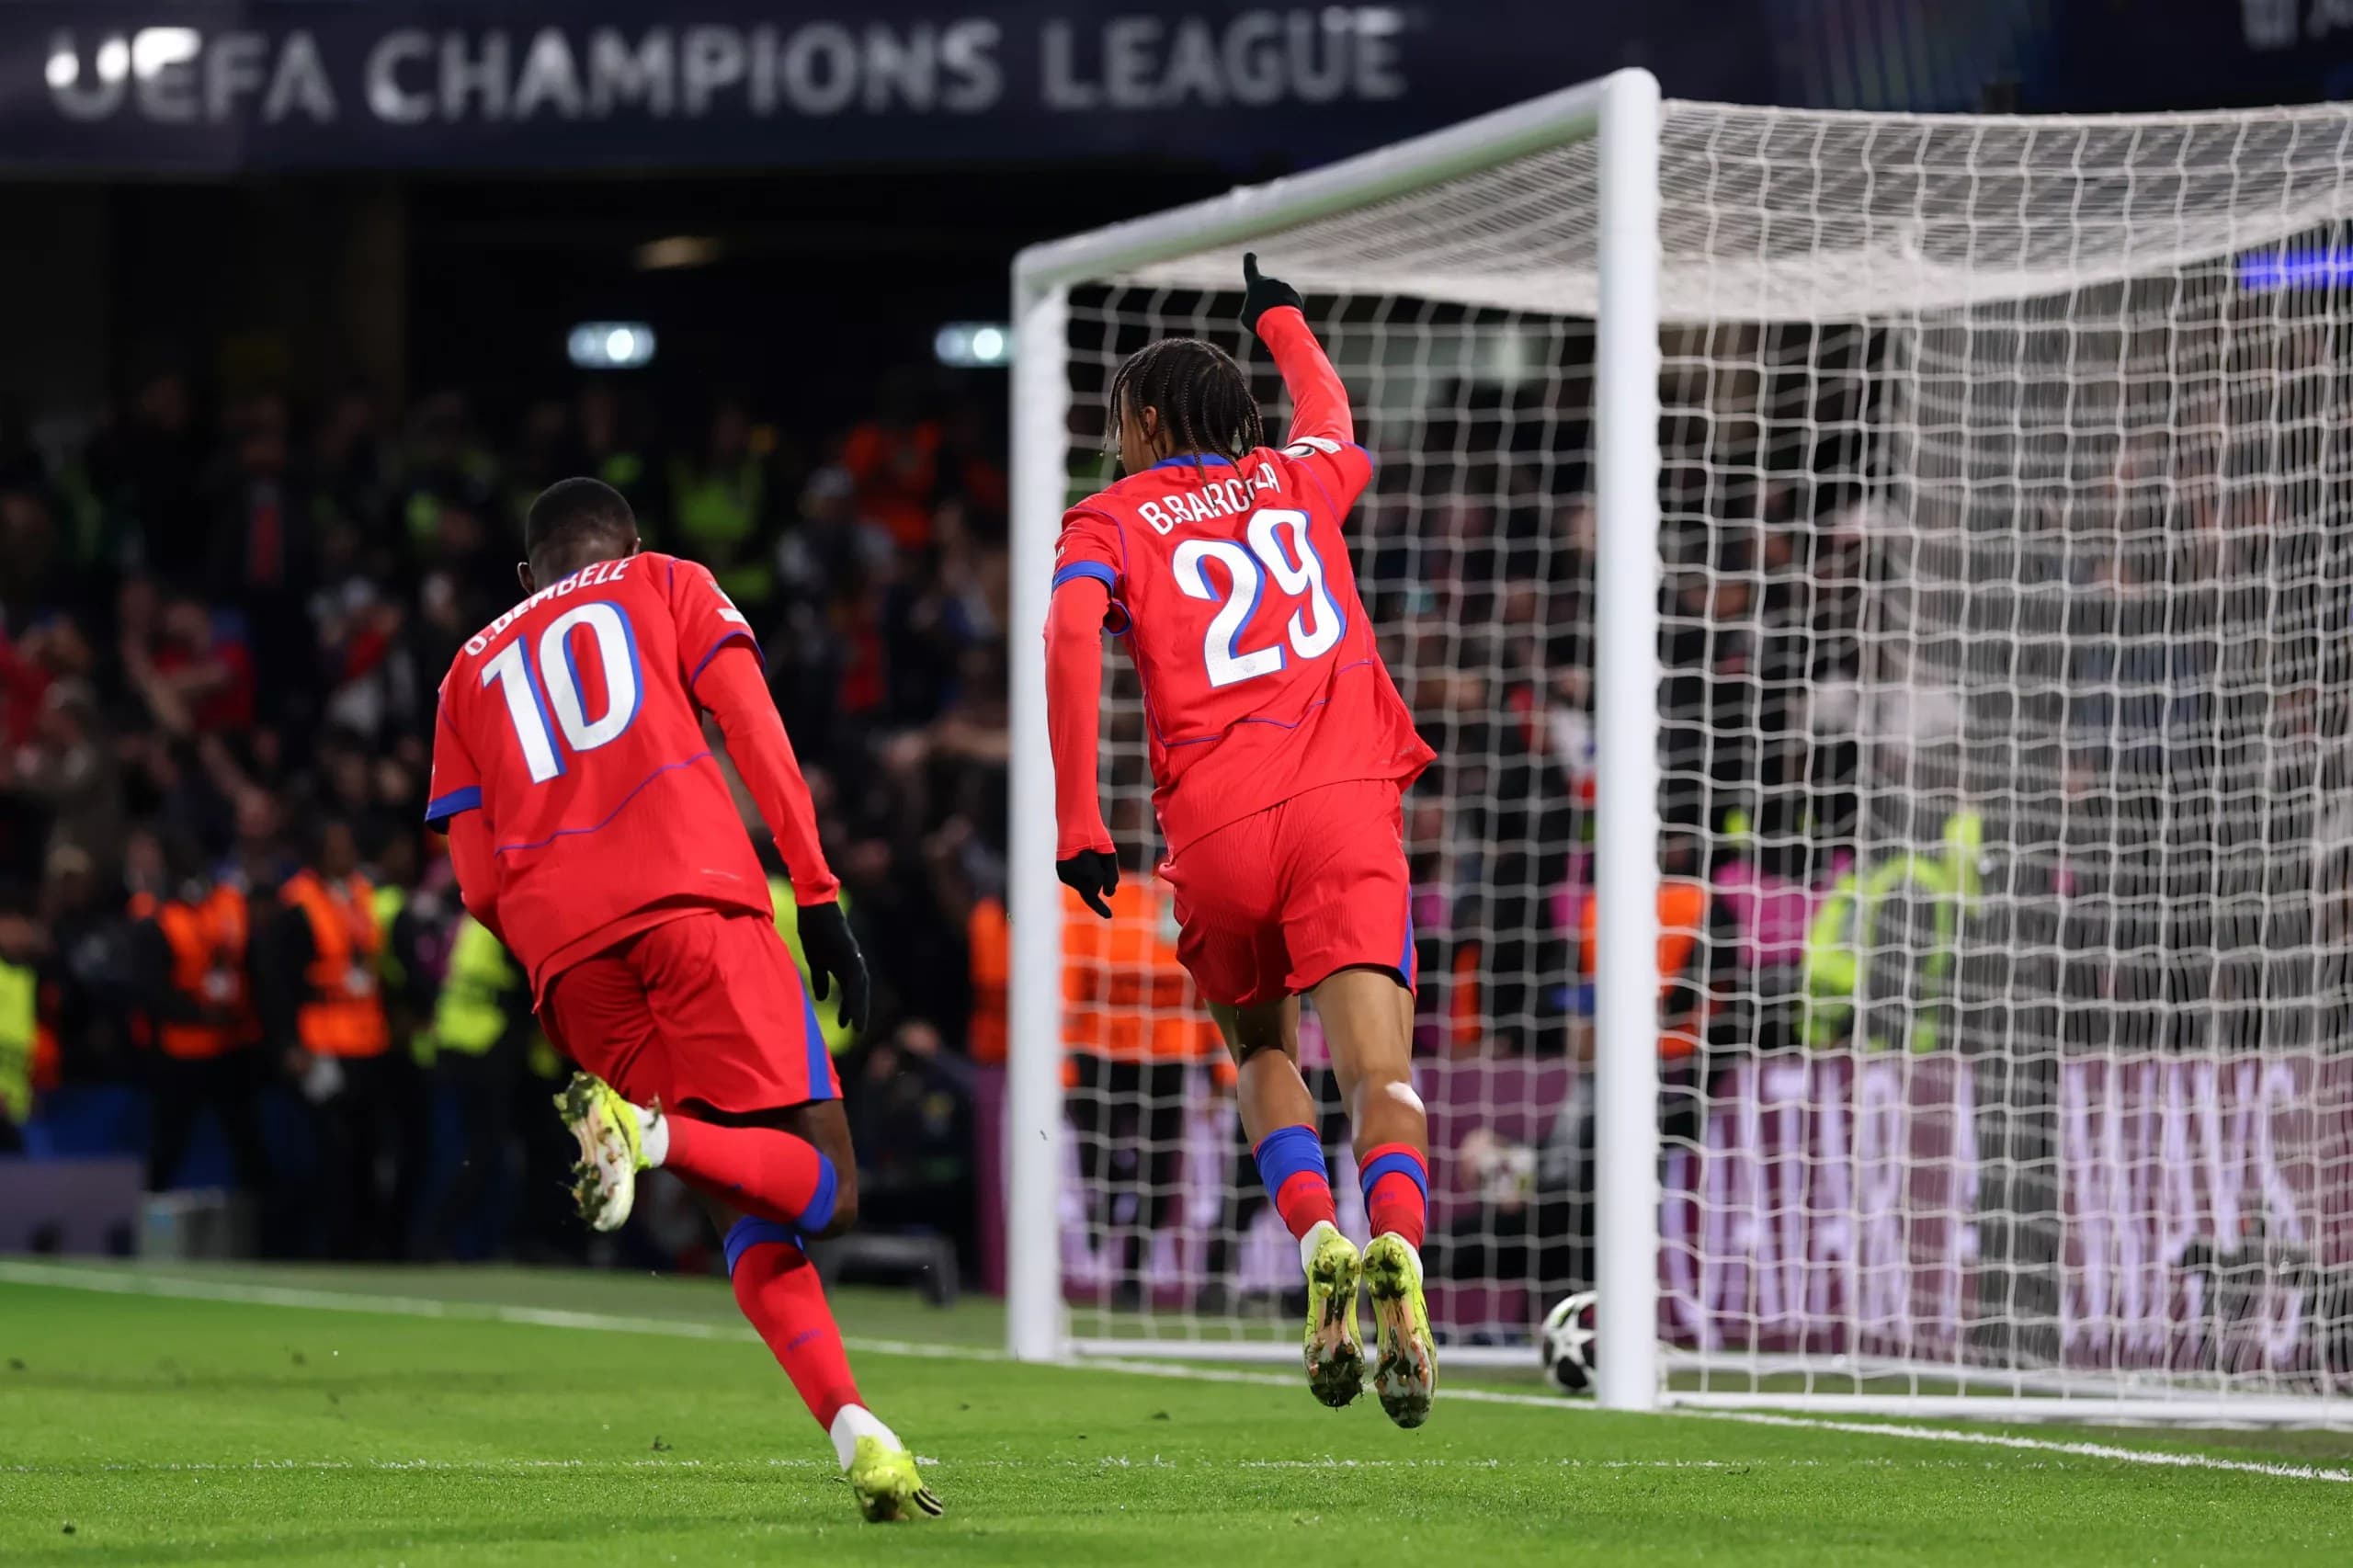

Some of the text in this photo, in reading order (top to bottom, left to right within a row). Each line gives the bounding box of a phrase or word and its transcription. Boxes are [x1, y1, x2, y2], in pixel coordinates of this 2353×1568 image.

[44, 7, 1409, 123] UEFA CHAMPIONS LEAGUE
[1171, 507, 1347, 688] 29
[480, 599, 645, 785] 10
